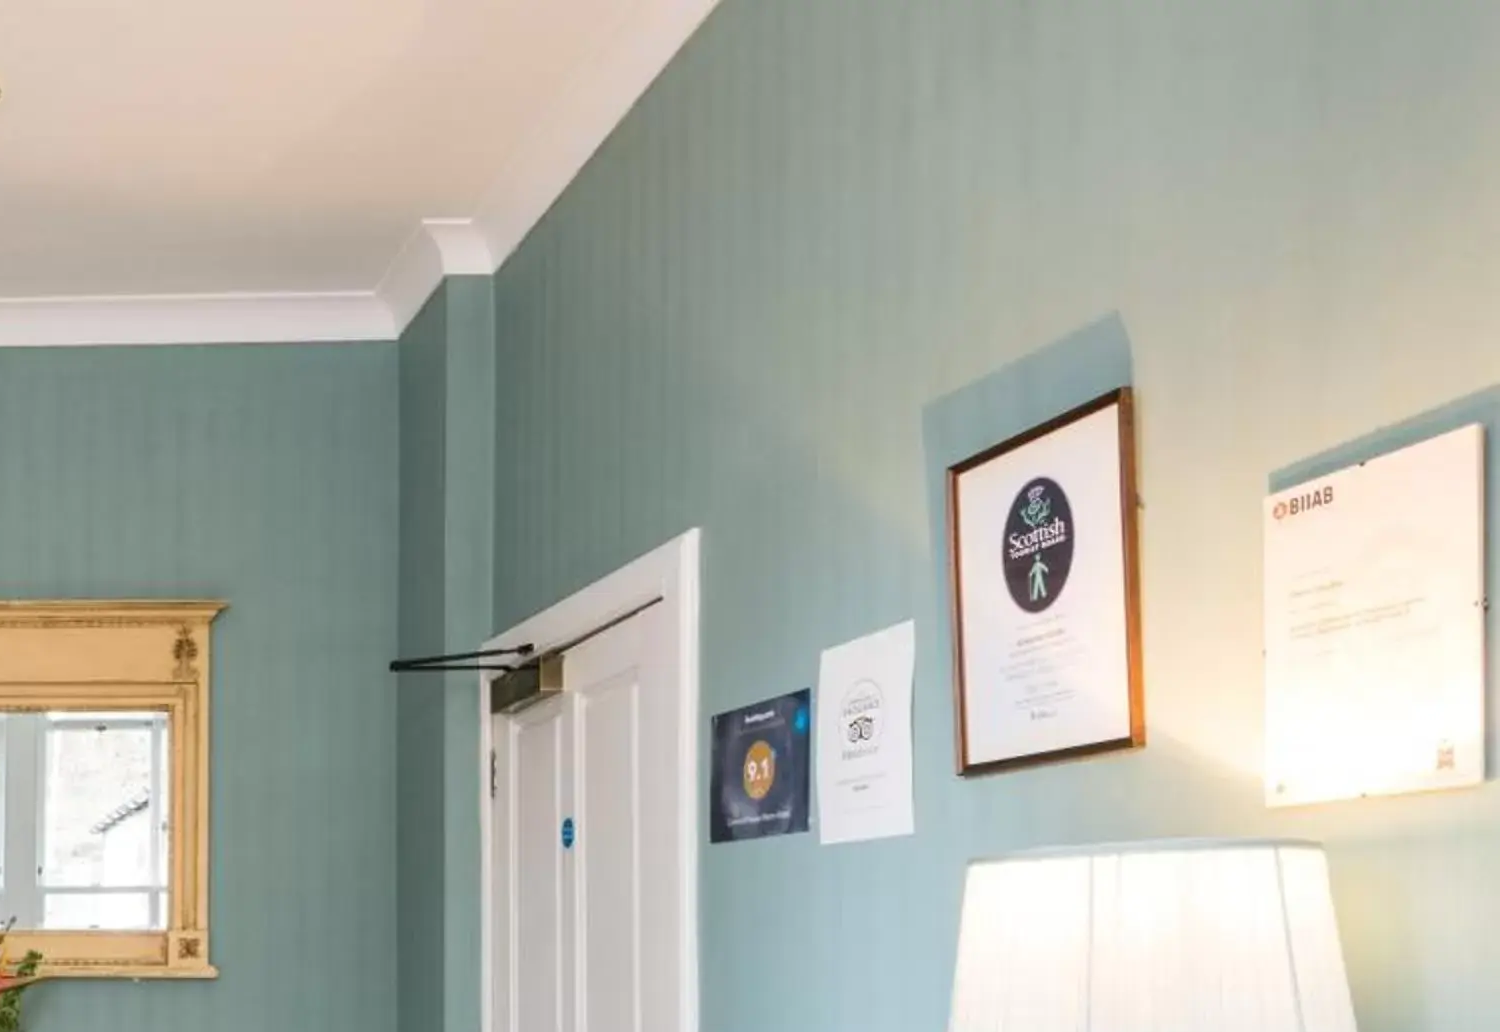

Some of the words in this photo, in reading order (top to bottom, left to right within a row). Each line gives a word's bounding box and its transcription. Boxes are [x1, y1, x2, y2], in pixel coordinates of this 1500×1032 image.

[1289, 486, 1334, 516] BIIAB
[1008, 516, 1065, 549] Scottish
[747, 758, 770, 783] 9.1
